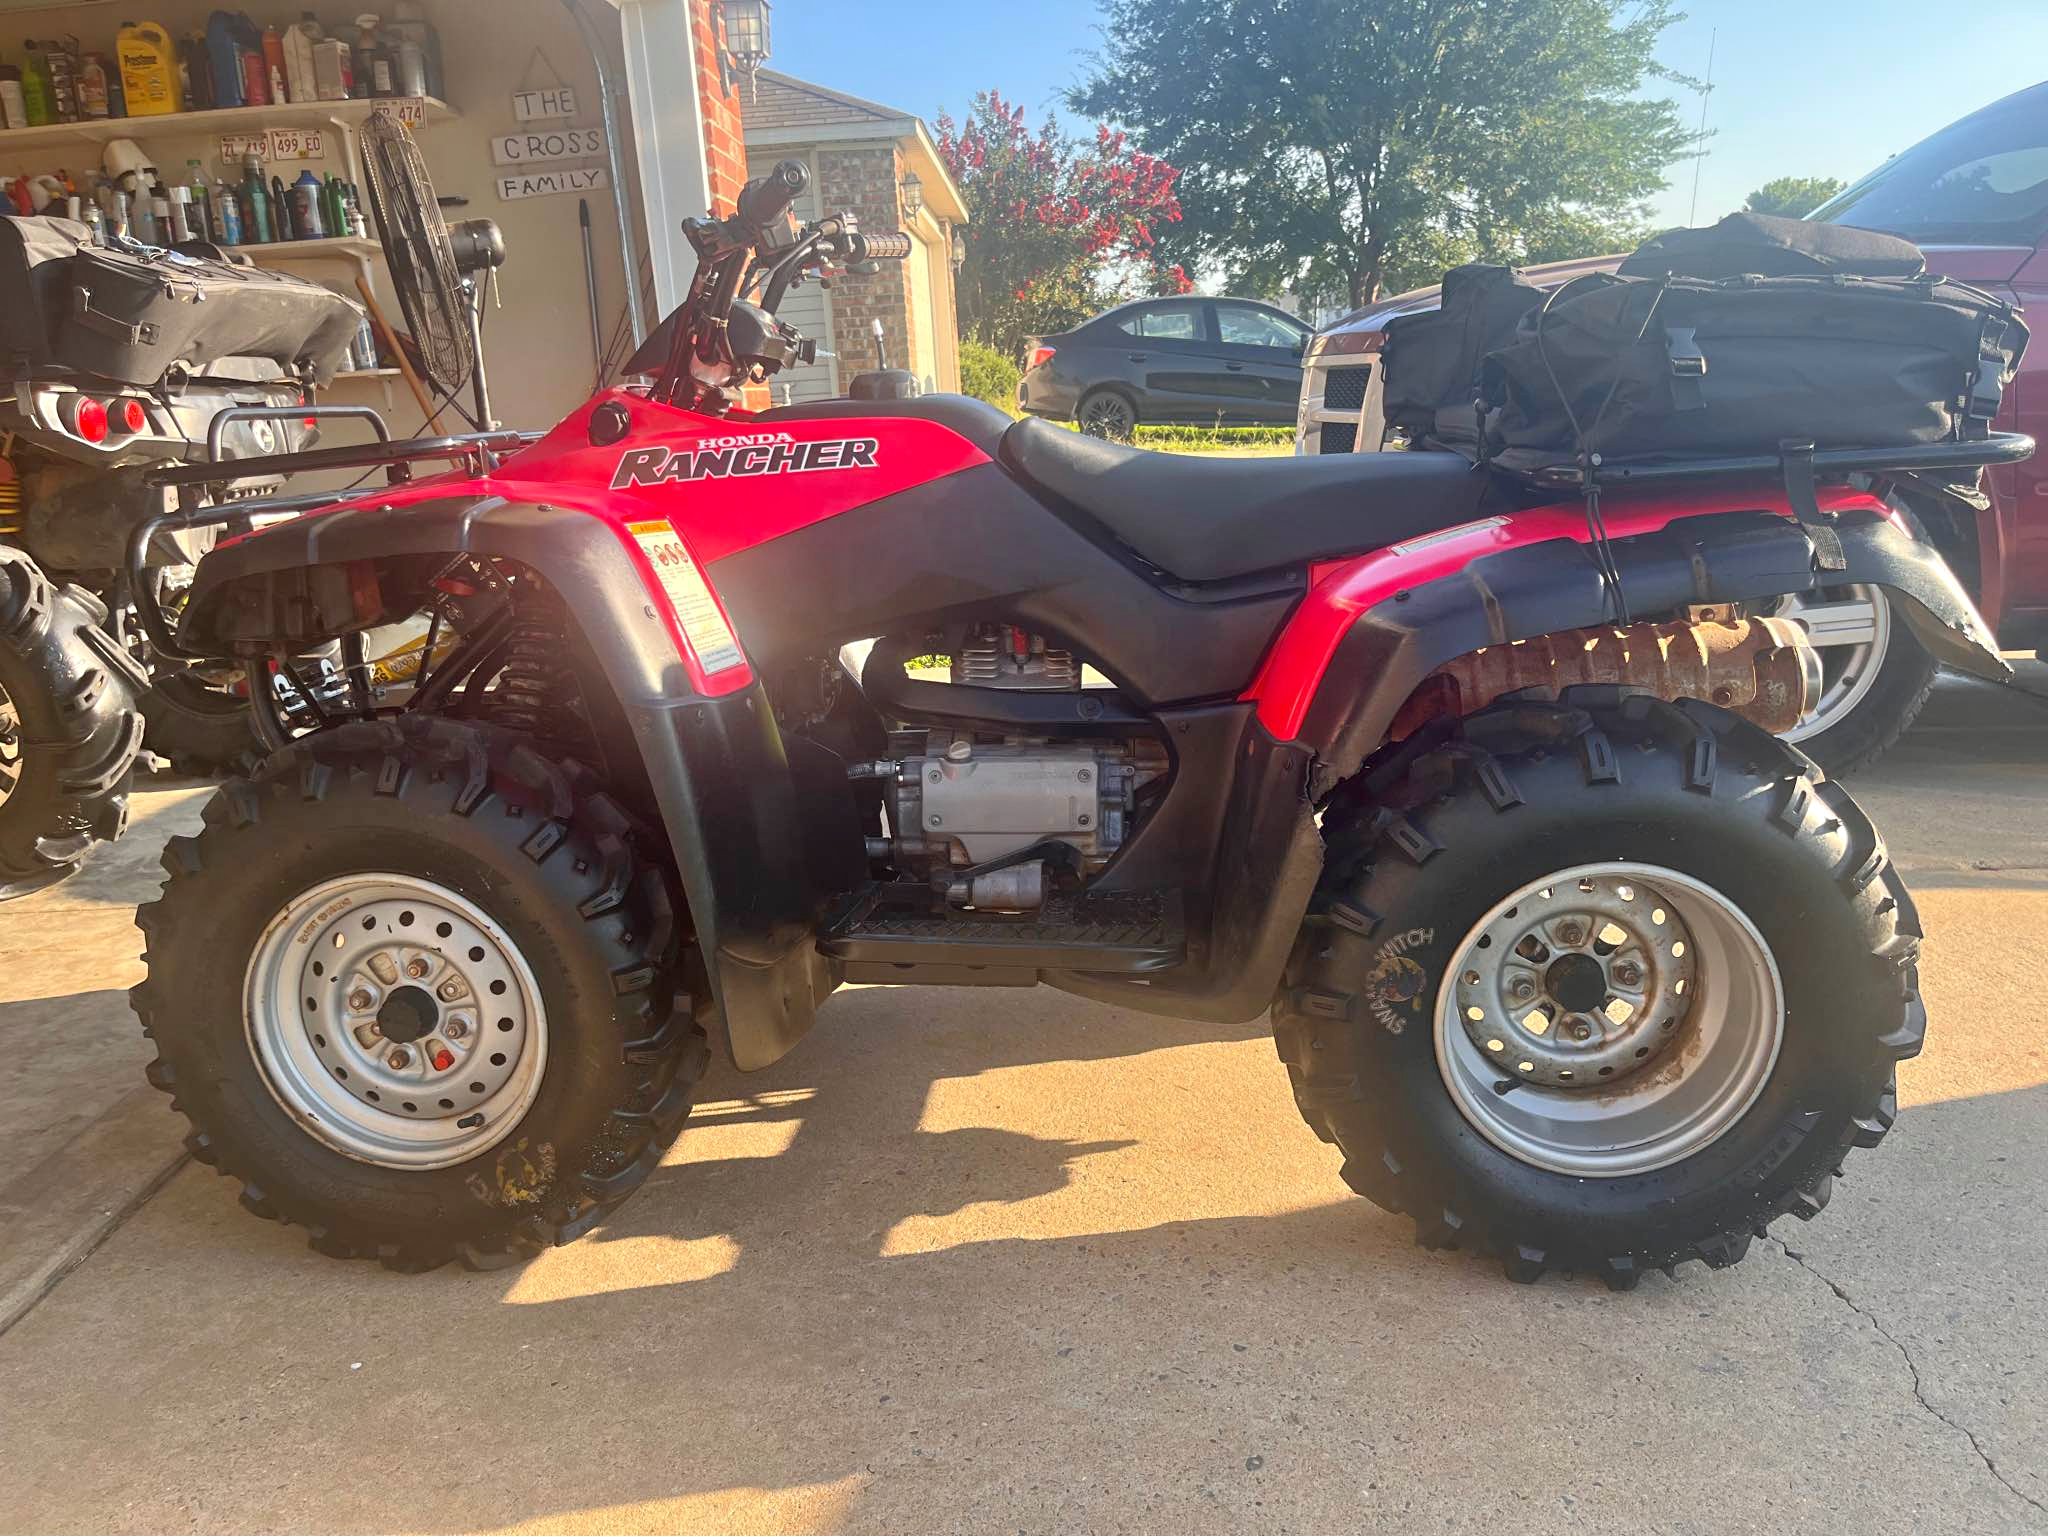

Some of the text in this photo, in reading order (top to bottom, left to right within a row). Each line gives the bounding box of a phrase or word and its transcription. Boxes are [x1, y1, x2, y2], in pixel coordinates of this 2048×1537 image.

[399, 106, 421, 121] 474
[514, 90, 573, 116] THE
[277, 137, 298, 153] 499
[504, 131, 600, 159] CROSS
[697, 432, 795, 450] HONDA
[608, 437, 880, 490] RANCHER
[1374, 928, 1434, 960] WITCH
